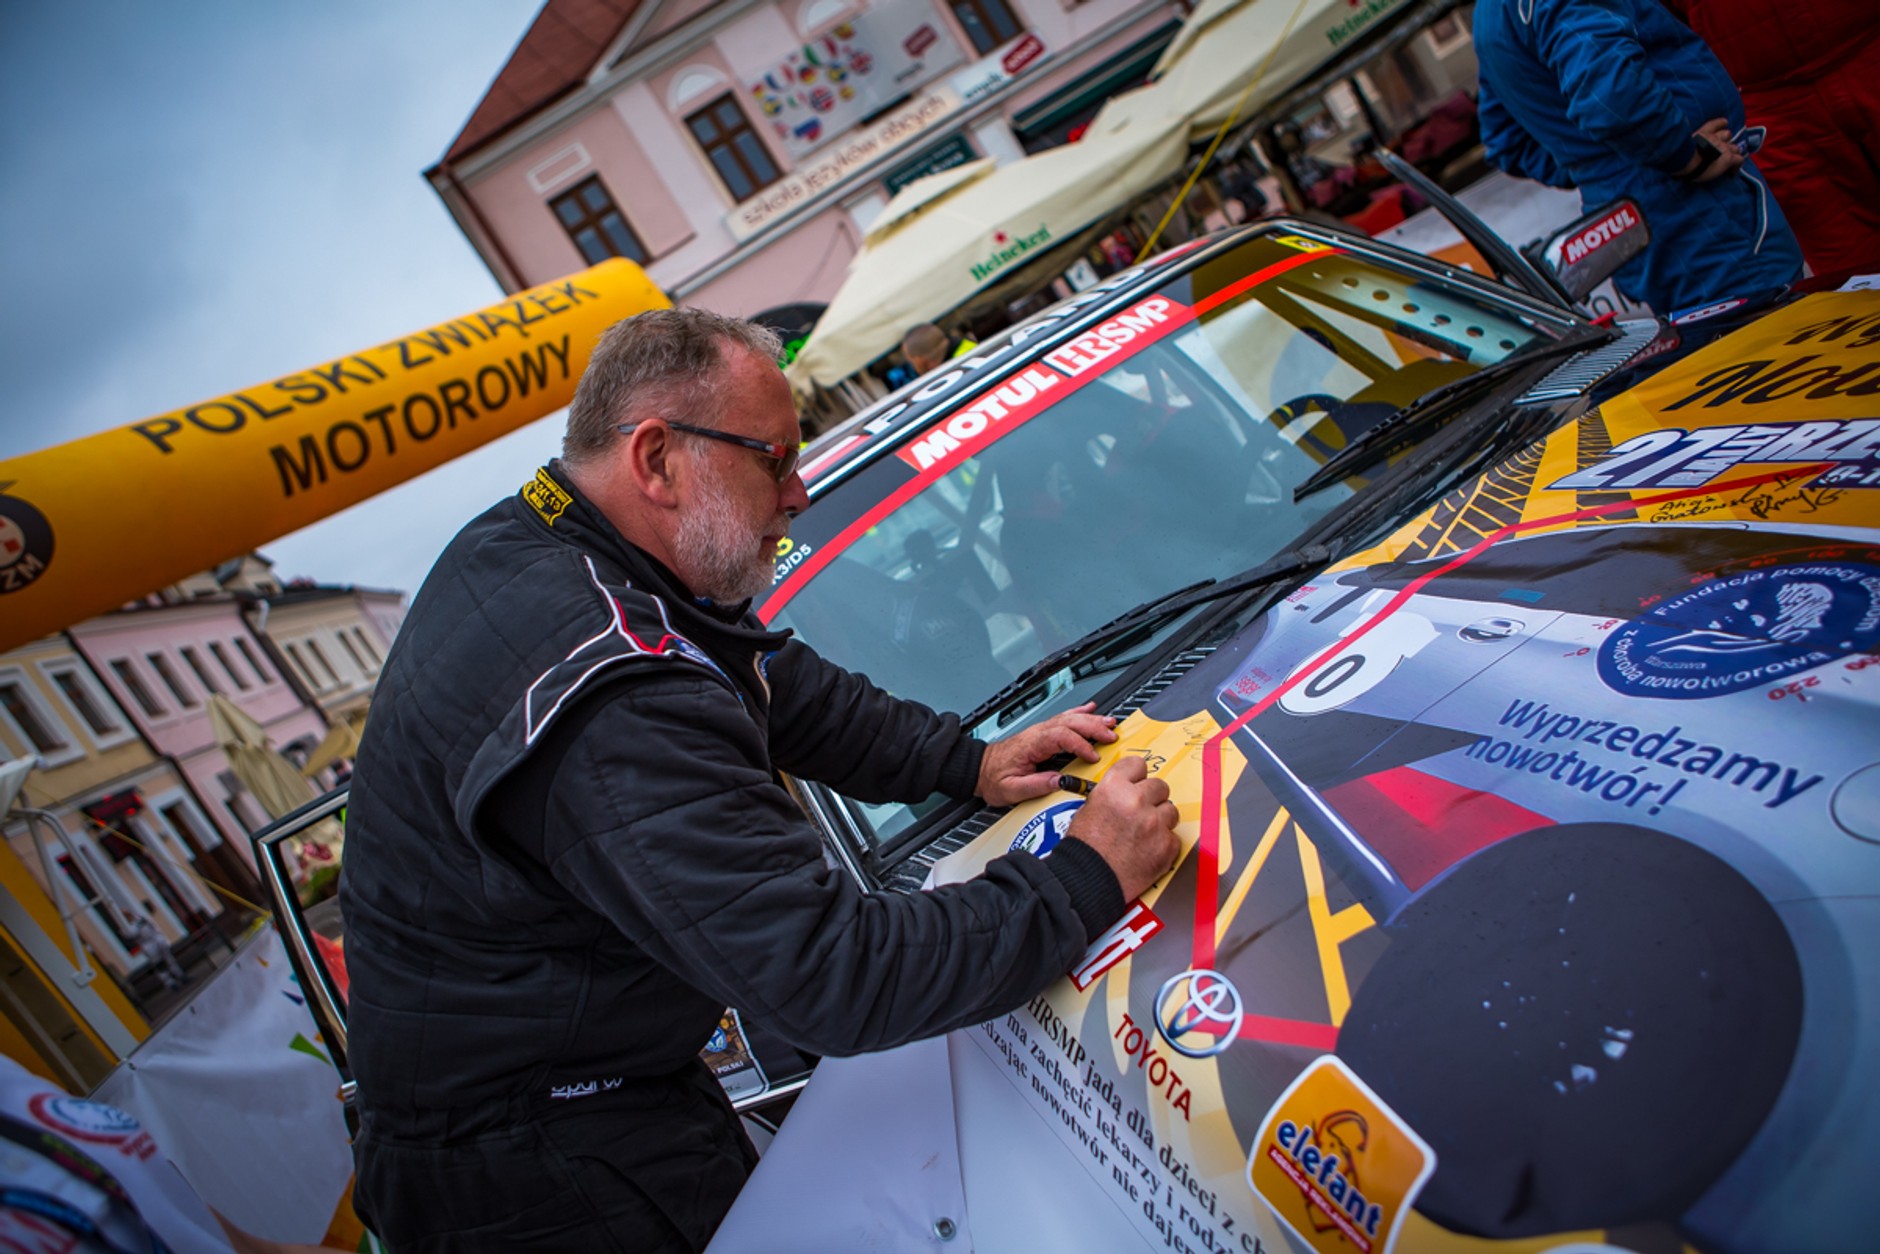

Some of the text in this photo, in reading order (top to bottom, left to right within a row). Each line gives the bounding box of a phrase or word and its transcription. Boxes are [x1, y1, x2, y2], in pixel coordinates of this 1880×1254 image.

[969, 223, 1051, 281] Heineken
[1567, 209, 1636, 262] MOTUL
[131, 281, 599, 454] POLSKI ZWIĄZEK
[864, 267, 1145, 434] POLAND
[269, 335, 573, 498] MOTOROWY
[910, 367, 1060, 473] MOTUL
[1654, 572, 1764, 616] Fundacja
[1771, 565, 1866, 581] pomocy
[1639, 651, 1831, 691] nowotworową
[1464, 736, 1689, 816] nowotwór!
[1498, 699, 1826, 809] Wyprzedzamy
[1007, 1012, 1028, 1047] ma
[1030, 1040, 1093, 1119] zachęcić
[1096, 1107, 1162, 1195] lekarzy
[1166, 1184, 1174, 1209] i
[1027, 994, 1087, 1068] HRSMP
[1083, 1058, 1123, 1121] jadą
[1126, 1107, 1154, 1151] dla
[1159, 1143, 1217, 1217] dzieci
[1221, 1211, 1235, 1236] z
[1113, 1012, 1191, 1123] TOYOTA
[1031, 1072, 1109, 1167] nowotwór
[1112, 1163, 1139, 1203] nie
[1276, 1119, 1382, 1237] elefant
